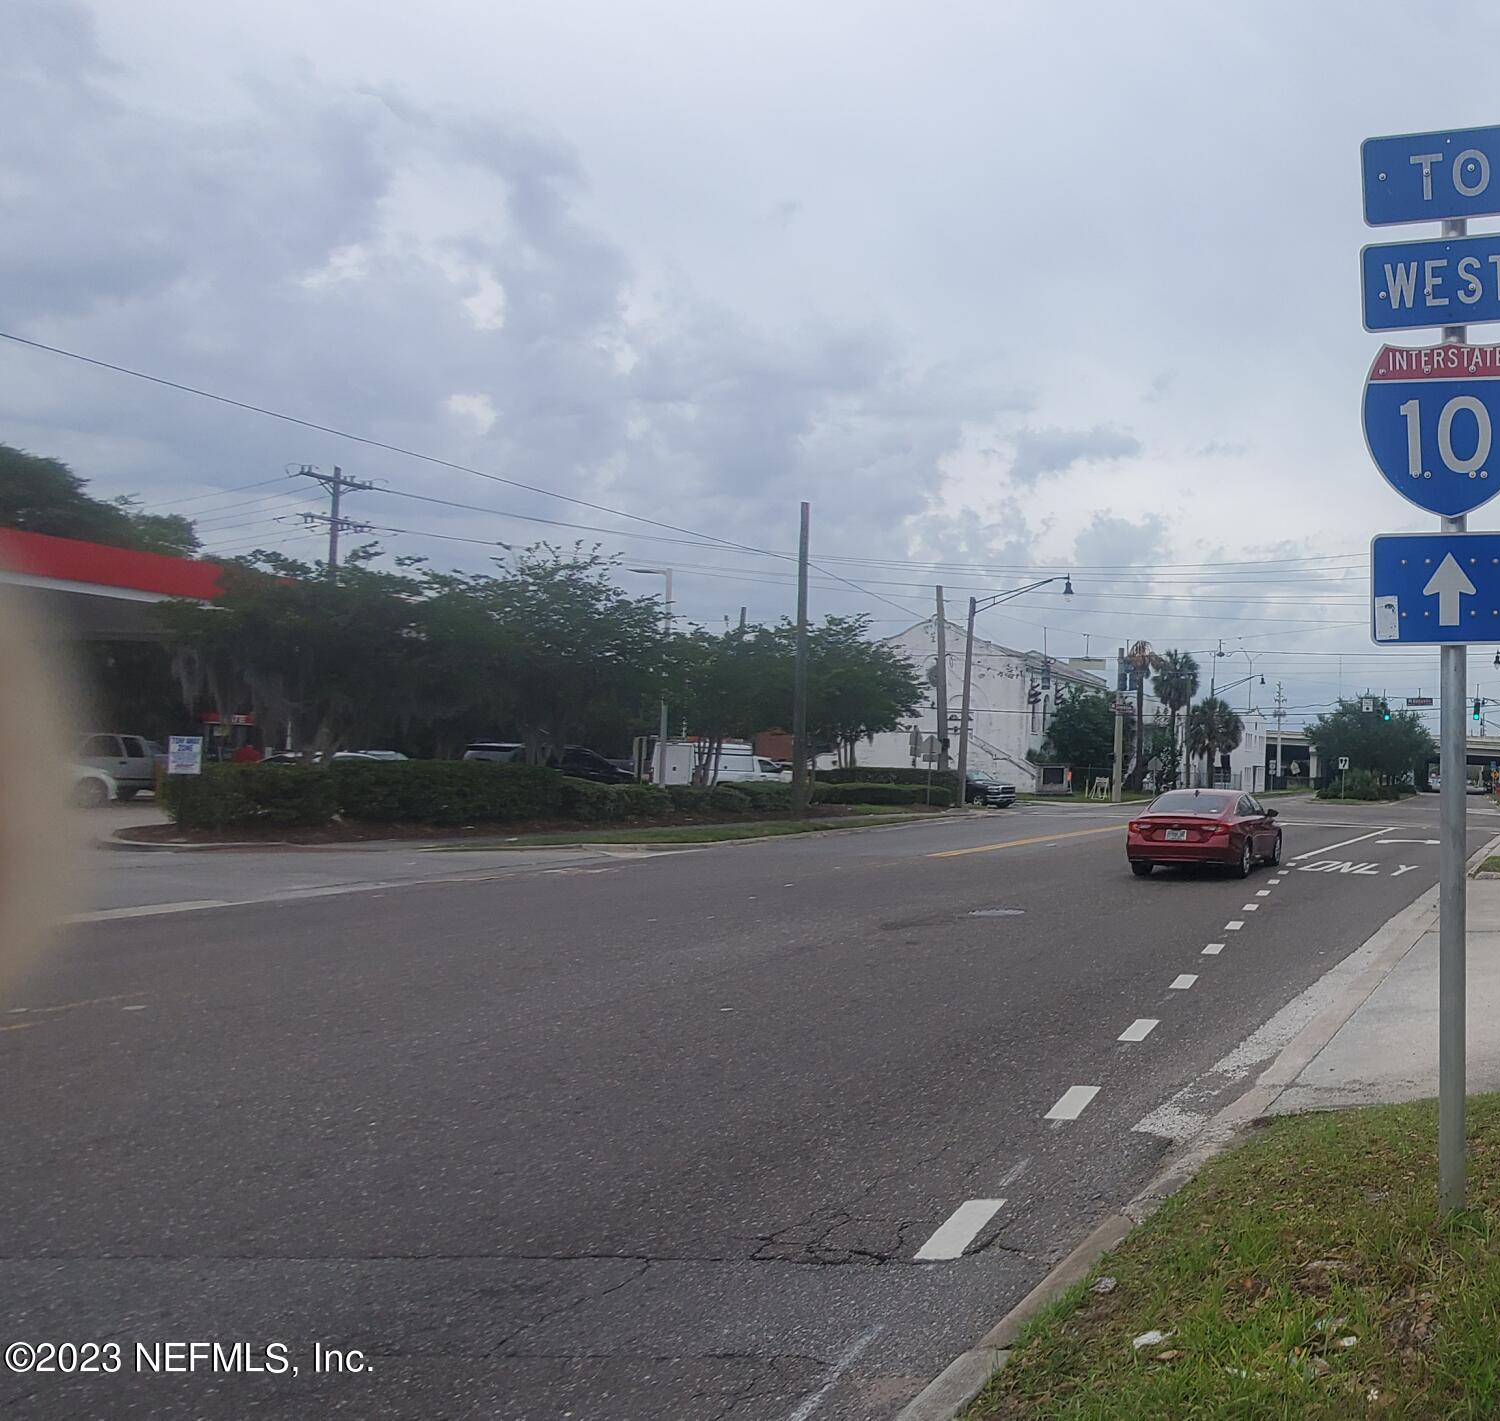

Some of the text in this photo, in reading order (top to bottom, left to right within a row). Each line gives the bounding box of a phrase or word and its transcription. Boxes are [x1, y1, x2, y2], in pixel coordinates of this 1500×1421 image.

[1410, 149, 1490, 200] TO
[1400, 396, 1492, 476] 10
[1296, 860, 1421, 877] ONLY
